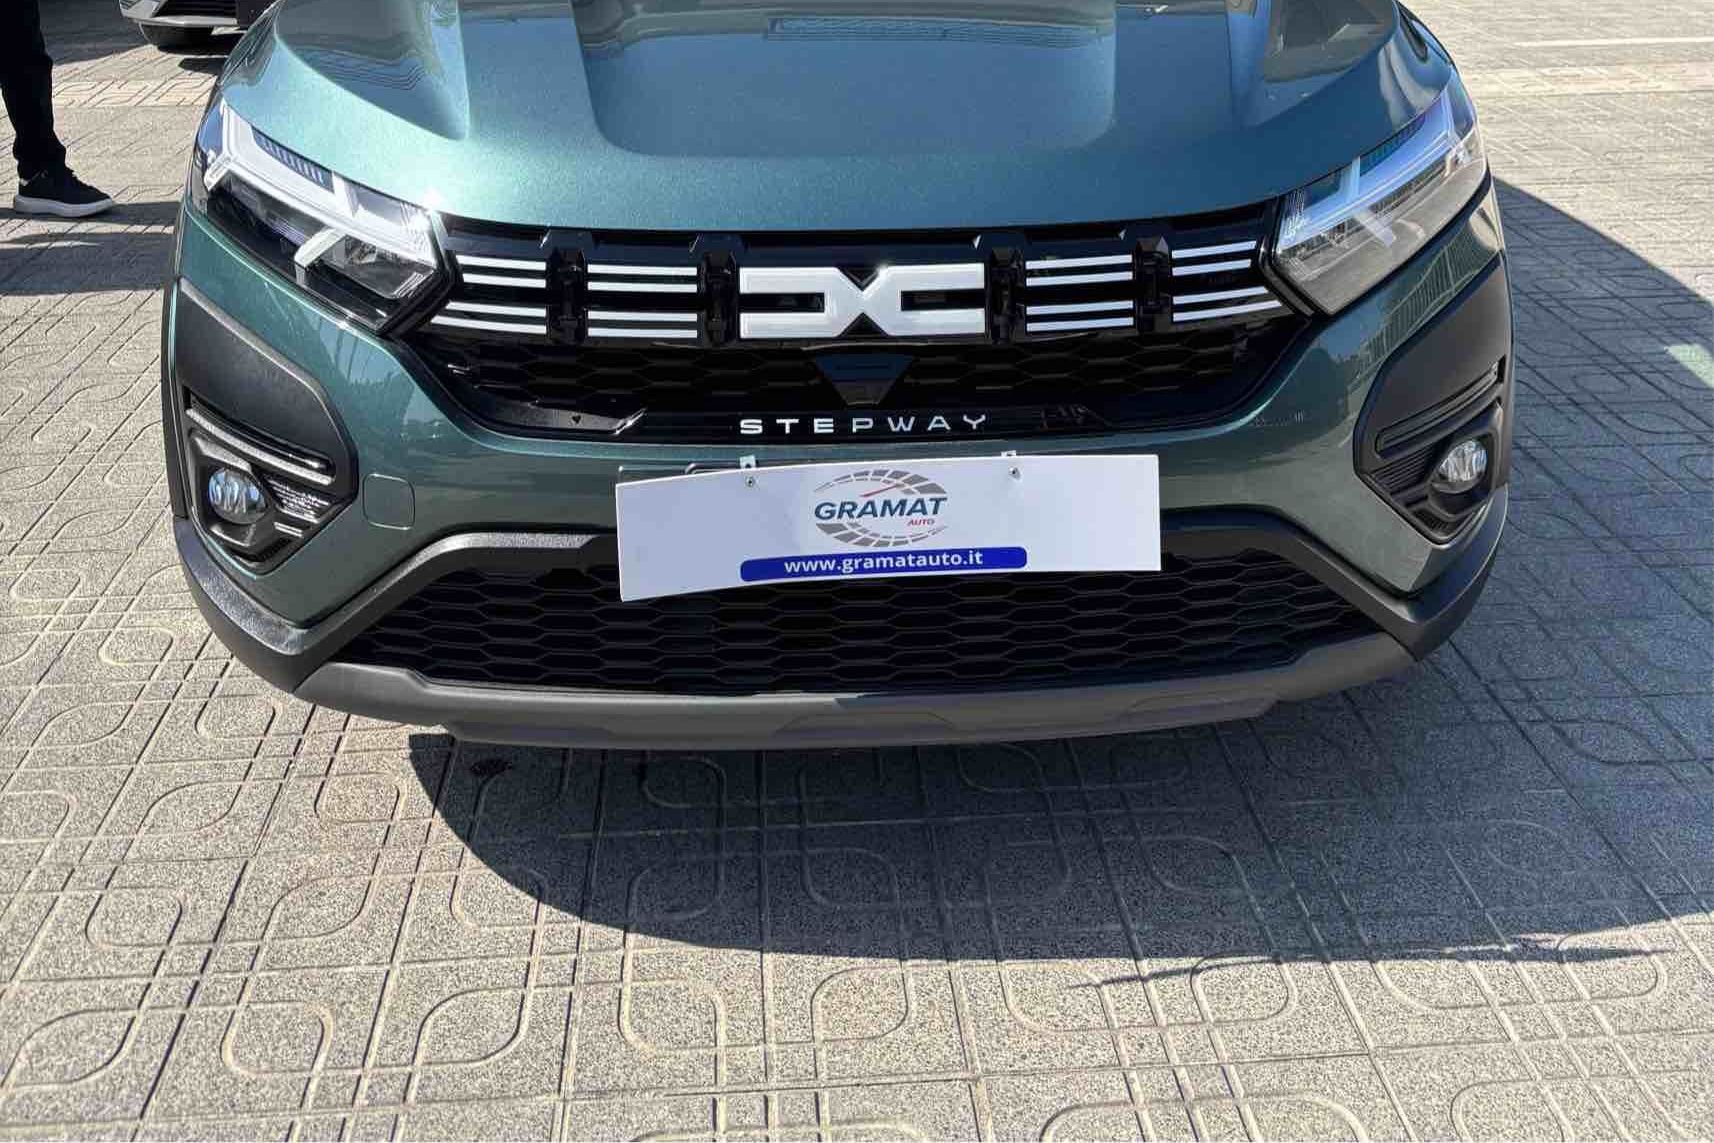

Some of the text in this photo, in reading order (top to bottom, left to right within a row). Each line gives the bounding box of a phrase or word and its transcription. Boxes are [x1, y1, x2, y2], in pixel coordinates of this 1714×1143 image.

[739, 414, 986, 435] STEPWAY
[814, 497, 948, 520] GRAMAT
[906, 518, 936, 527] AUTO
[784, 550, 984, 574] www.gramatauto.it
